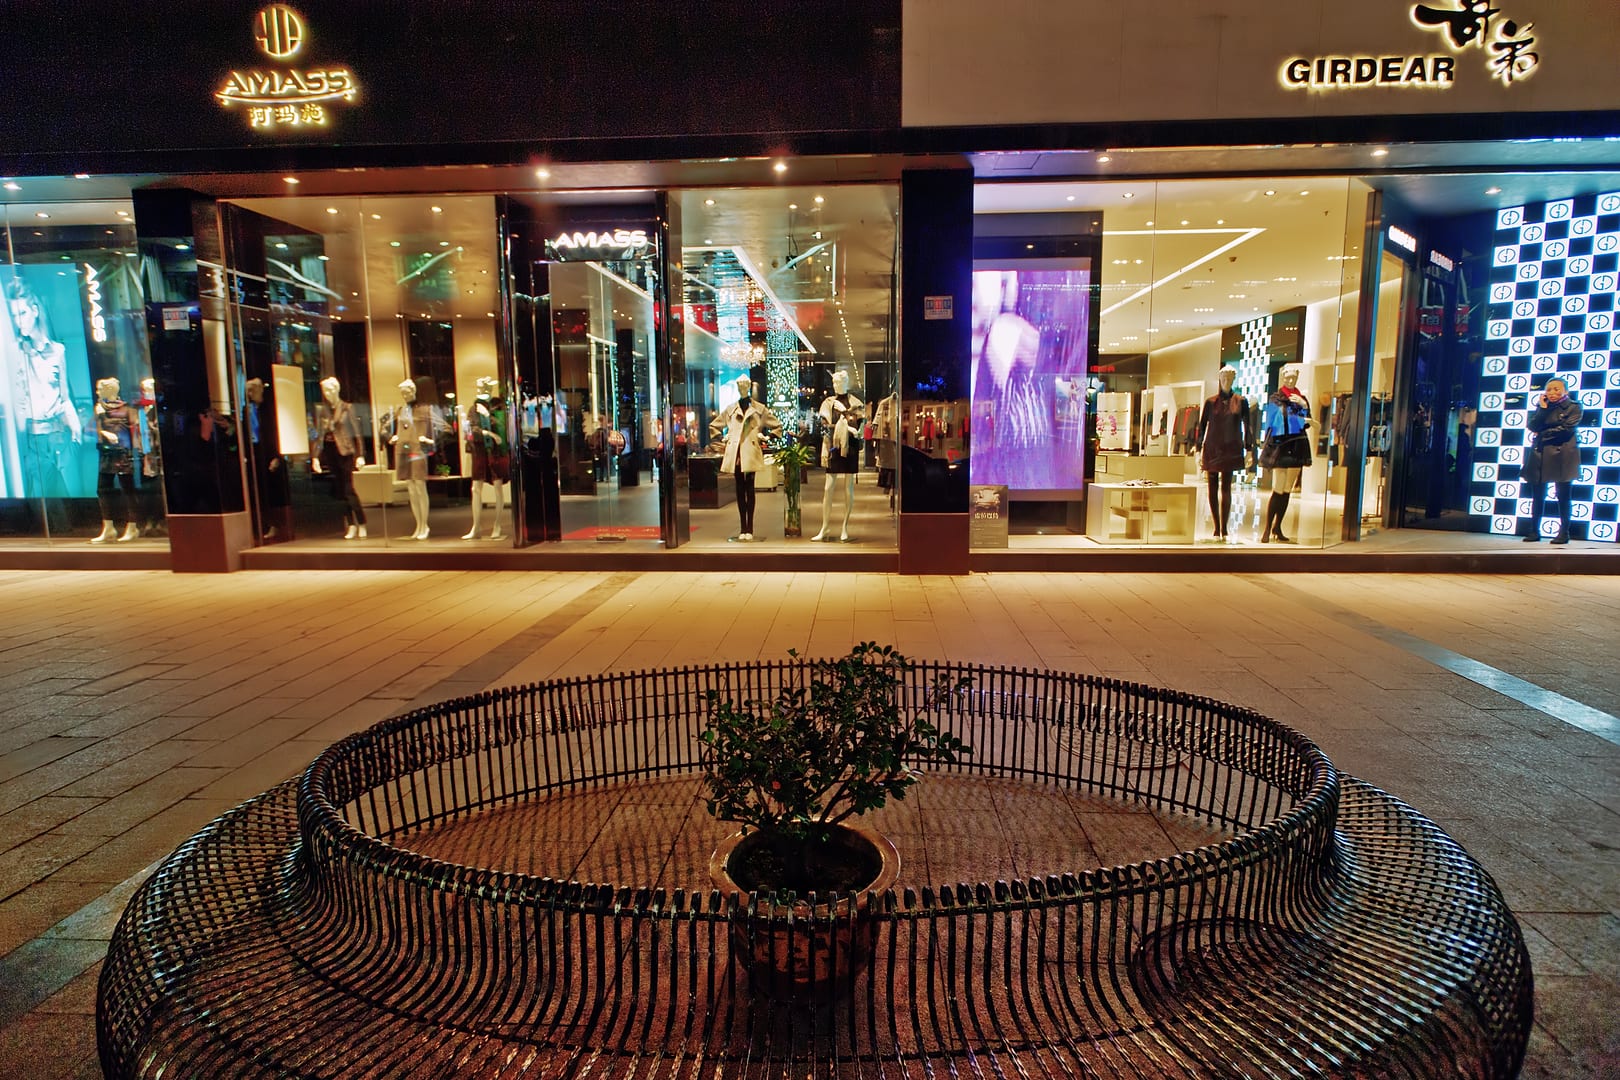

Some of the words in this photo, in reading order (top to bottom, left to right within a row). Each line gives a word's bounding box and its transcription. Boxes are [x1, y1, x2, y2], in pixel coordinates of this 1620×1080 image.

[220, 69, 353, 98] AMASS
[1287, 57, 1455, 84] GIRDEAR
[553, 229, 648, 249] AMASS
[83, 262, 107, 343] AMASS
